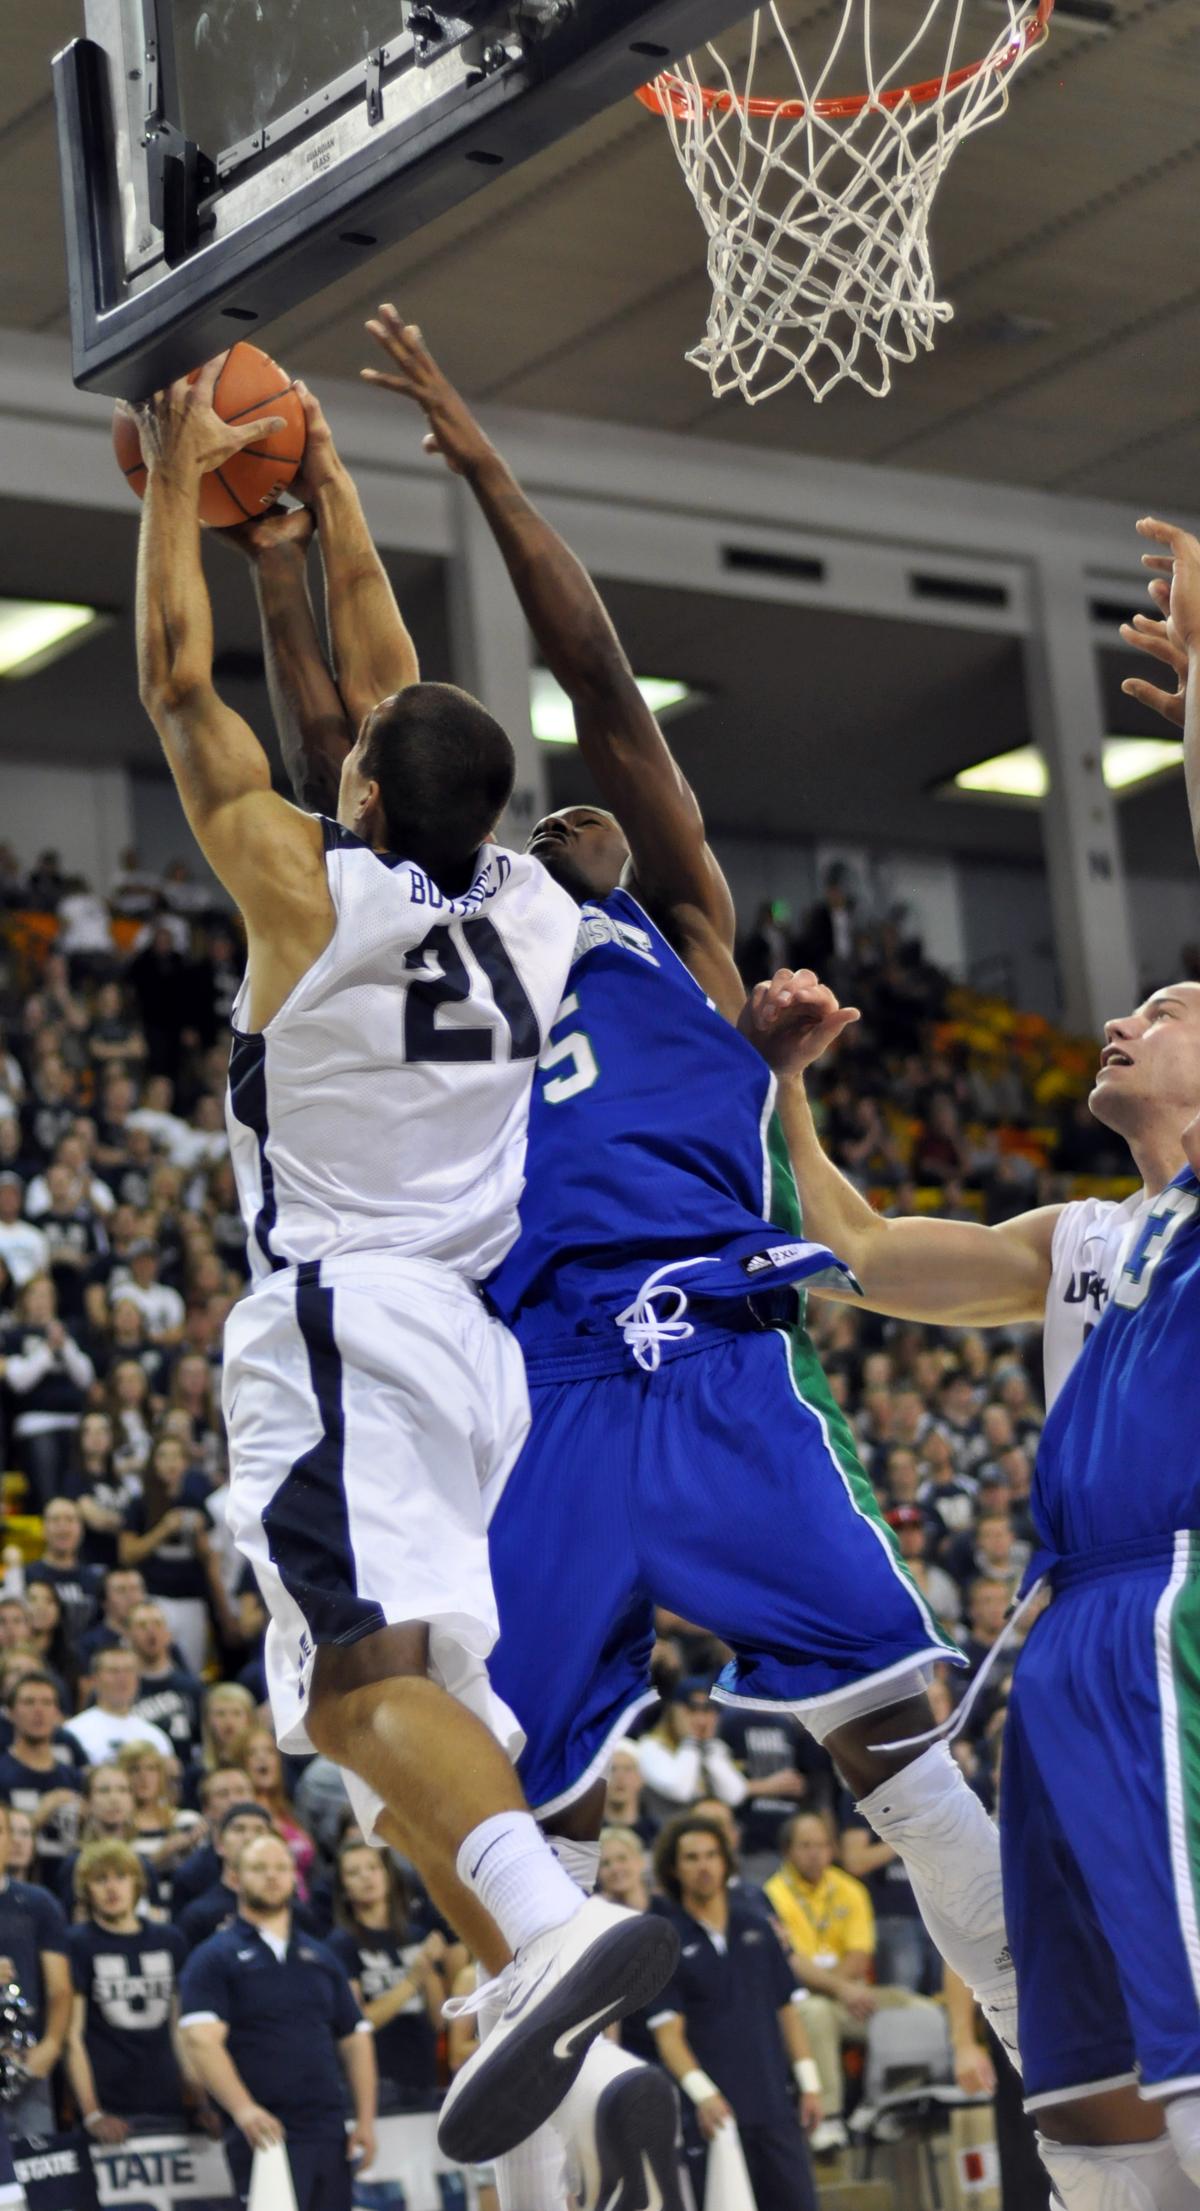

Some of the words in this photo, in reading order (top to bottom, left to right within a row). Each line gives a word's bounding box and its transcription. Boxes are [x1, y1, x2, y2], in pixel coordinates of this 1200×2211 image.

[403, 917, 541, 1064] 21
[771, 1249, 798, 1262] 2XL
[95, 2149, 196, 2189] TATE
